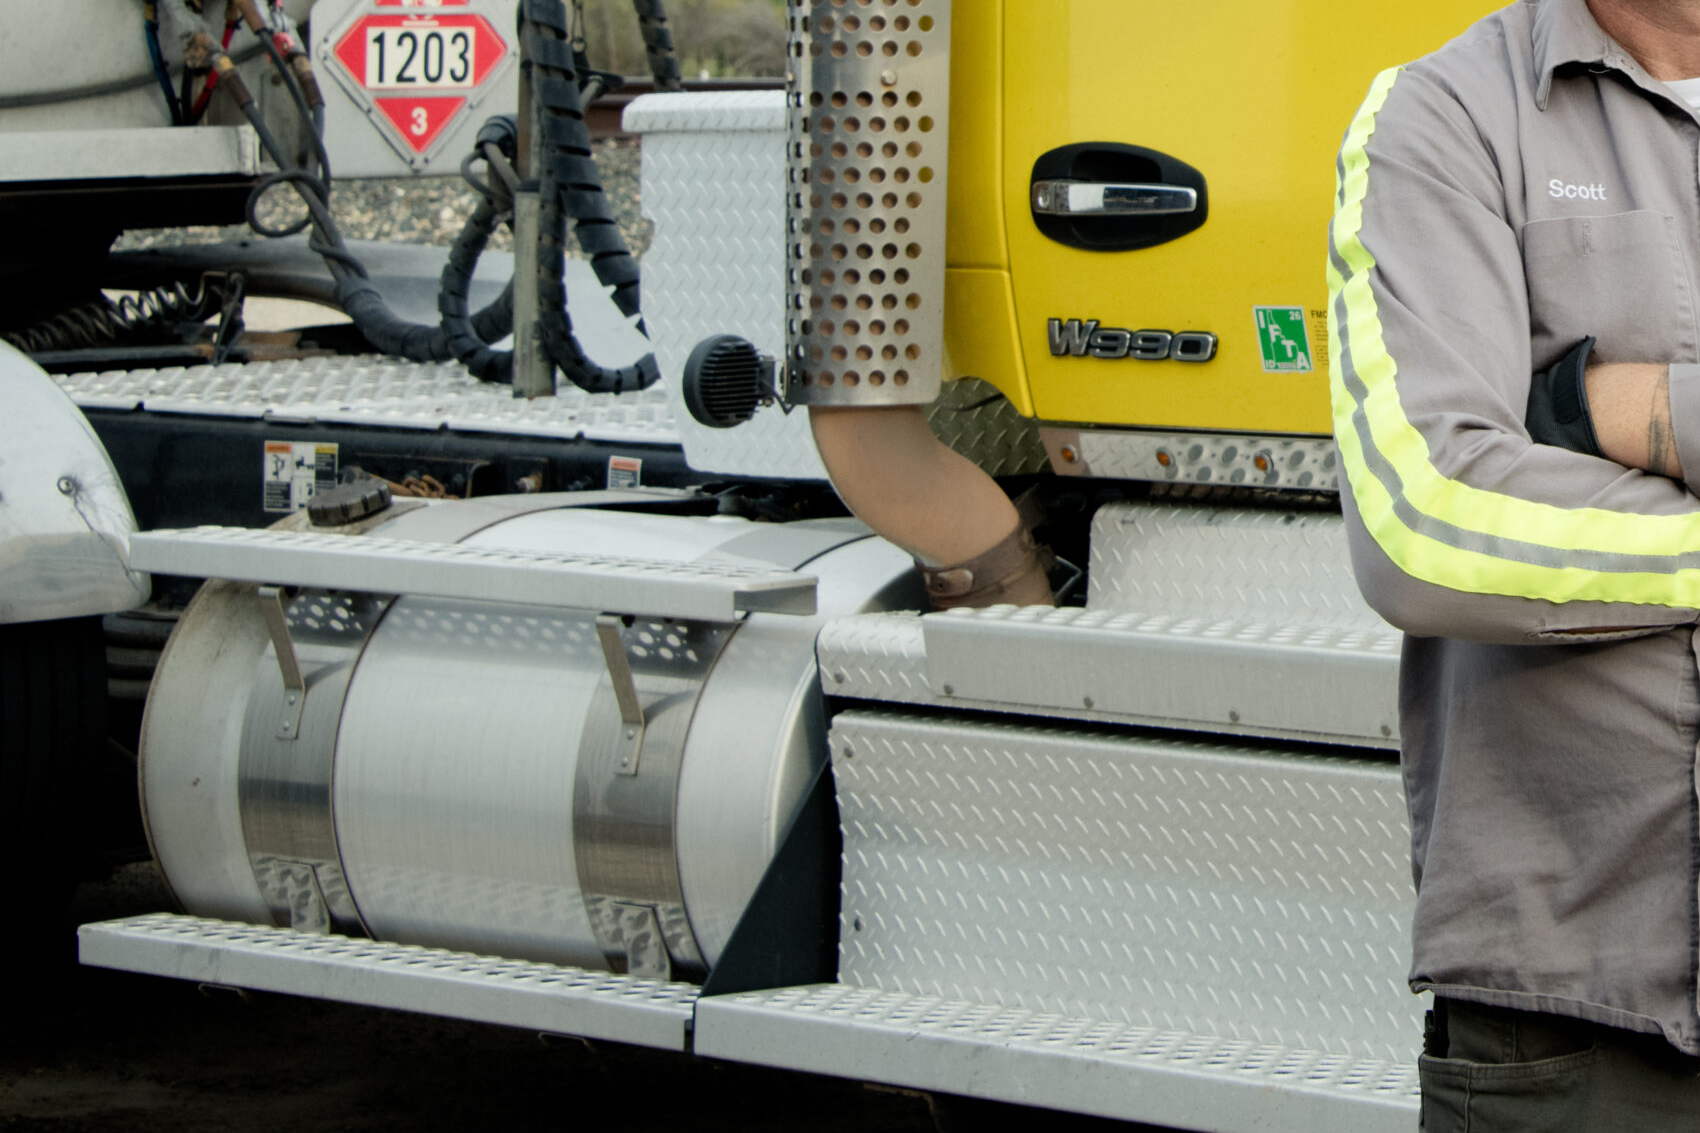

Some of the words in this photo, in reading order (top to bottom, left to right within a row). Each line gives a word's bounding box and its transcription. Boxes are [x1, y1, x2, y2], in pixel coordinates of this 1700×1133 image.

[372, 31, 470, 83] 1203
[411, 107, 428, 136] 3
[1548, 178, 1607, 201] Scott
[1048, 318, 1218, 363] W990
